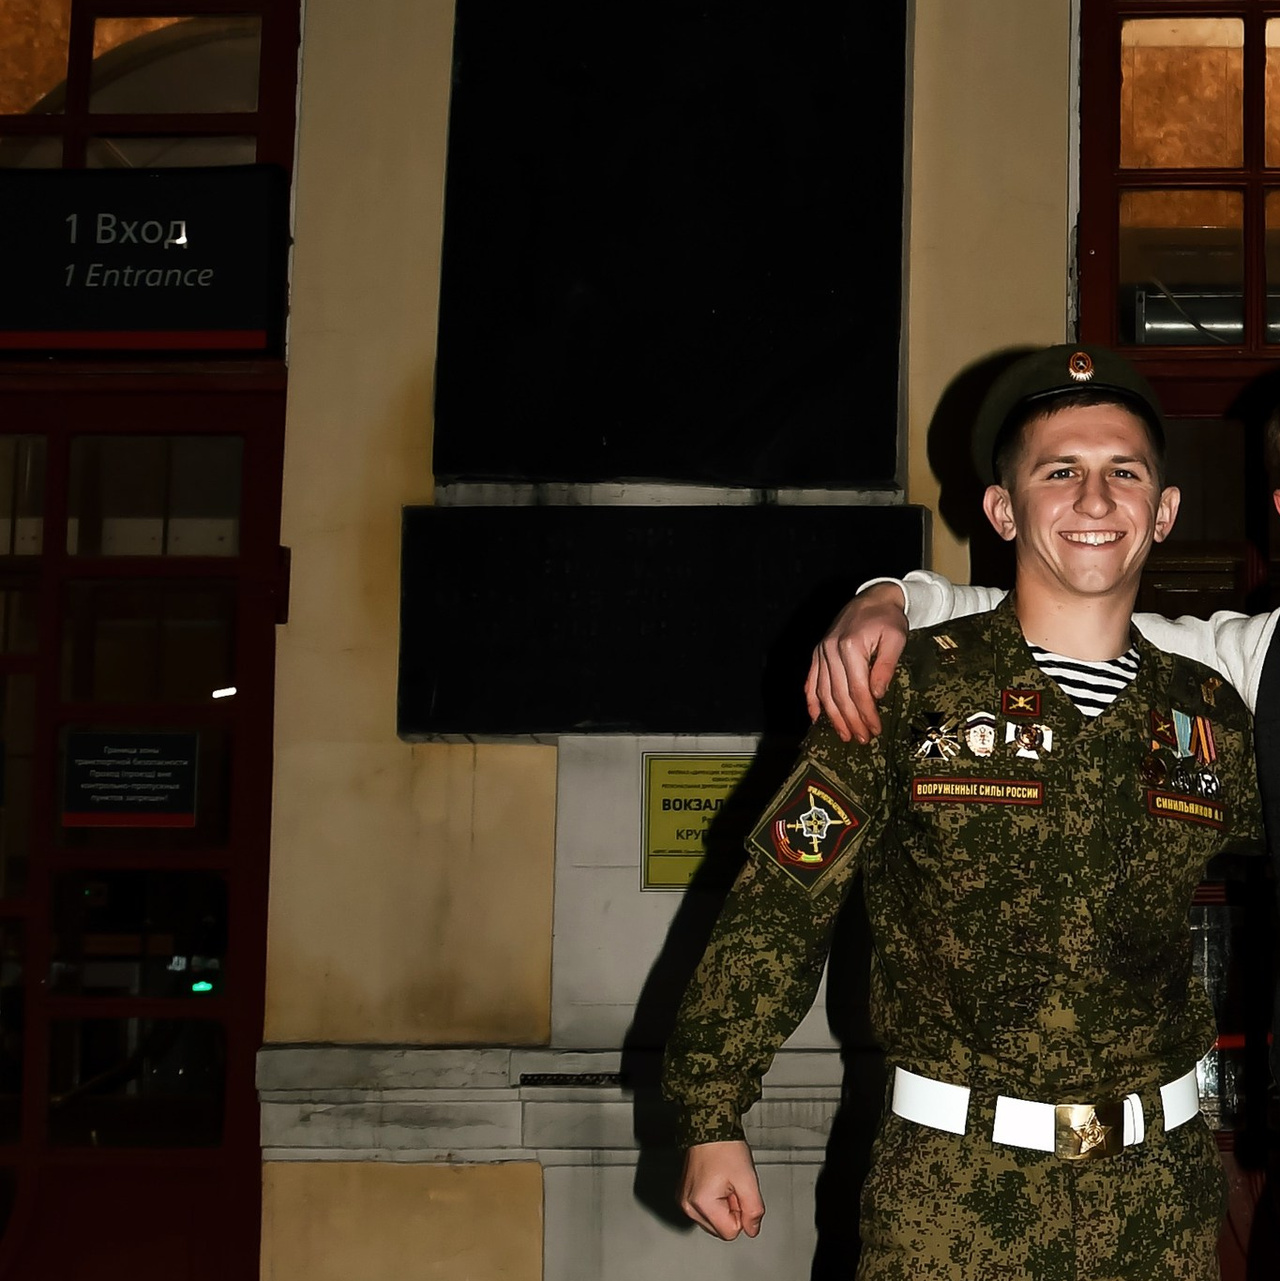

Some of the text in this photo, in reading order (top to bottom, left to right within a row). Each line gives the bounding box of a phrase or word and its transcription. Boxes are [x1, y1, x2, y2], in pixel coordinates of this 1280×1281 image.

[65, 213, 189, 249] 1 Вход
[64, 263, 214, 287] 1 Entrance
[917, 783, 1039, 799] ВООРУЖЕННЫЕ СИЛЫ РОССИИ
